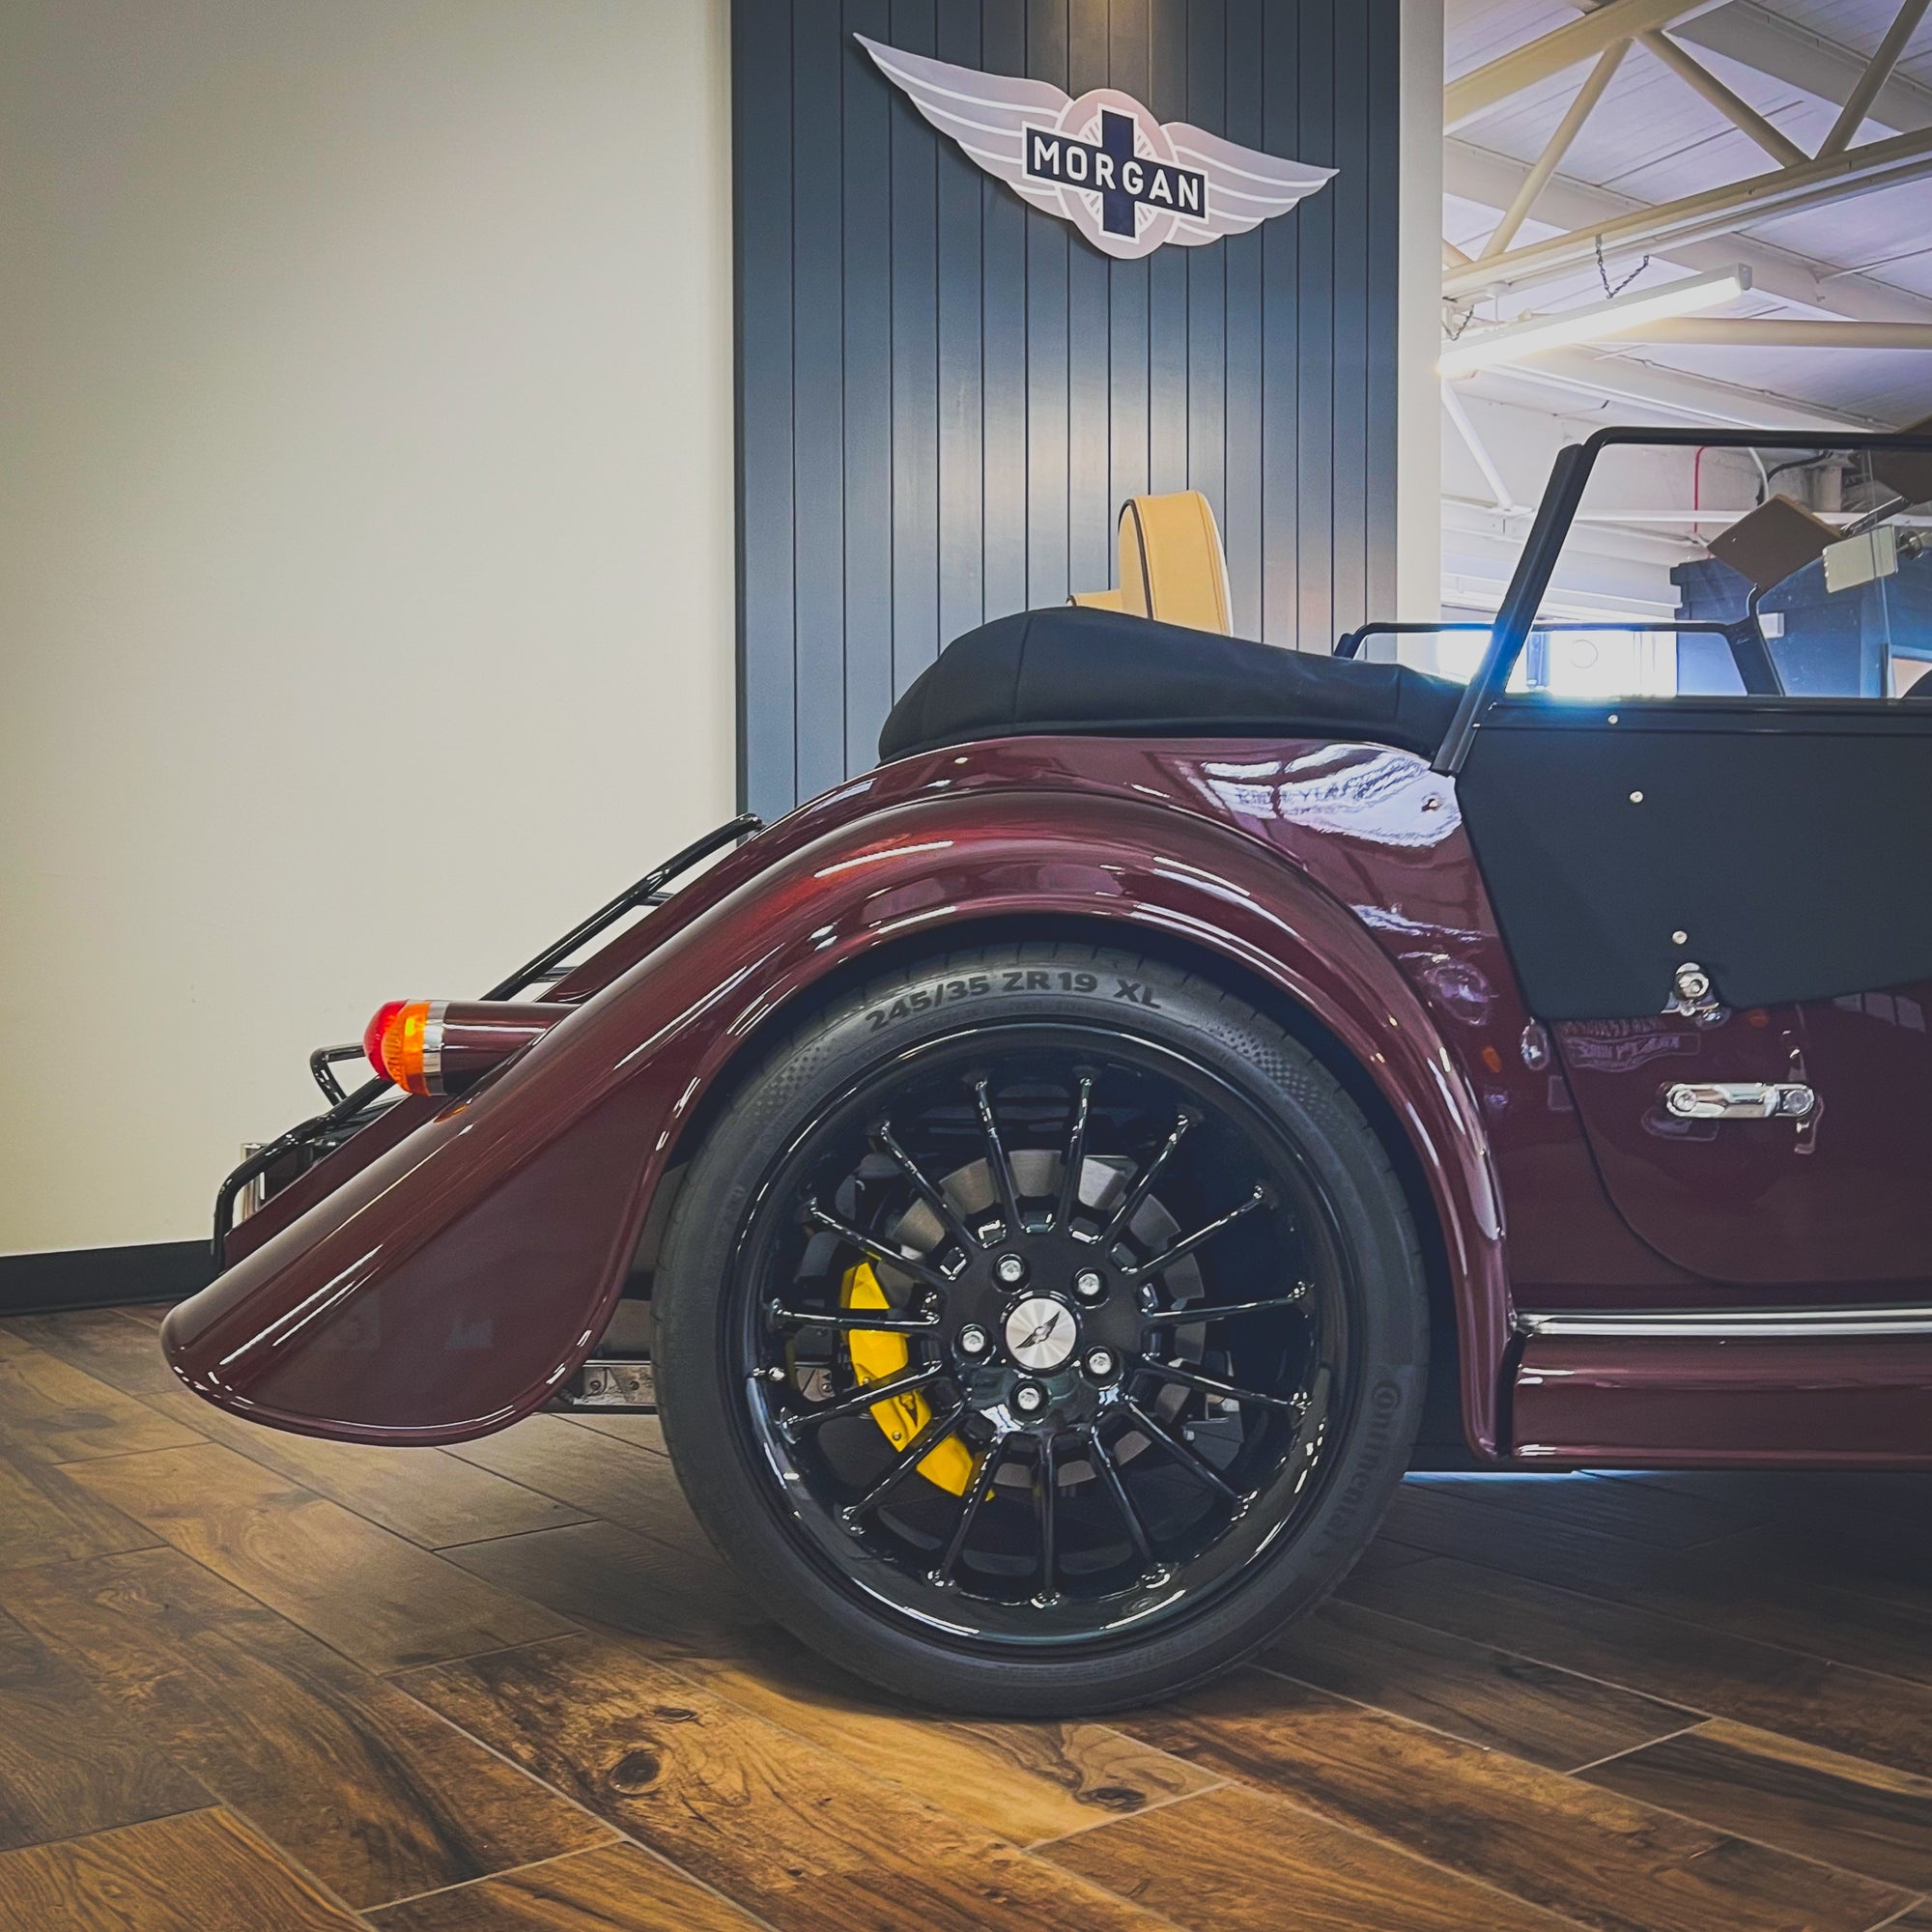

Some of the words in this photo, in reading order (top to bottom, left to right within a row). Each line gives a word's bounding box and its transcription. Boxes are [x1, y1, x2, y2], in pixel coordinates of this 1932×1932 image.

[1034, 136, 1199, 211] MORGAN
[865, 975, 991, 1033] 245/35
[1114, 979, 1162, 1009] XL
